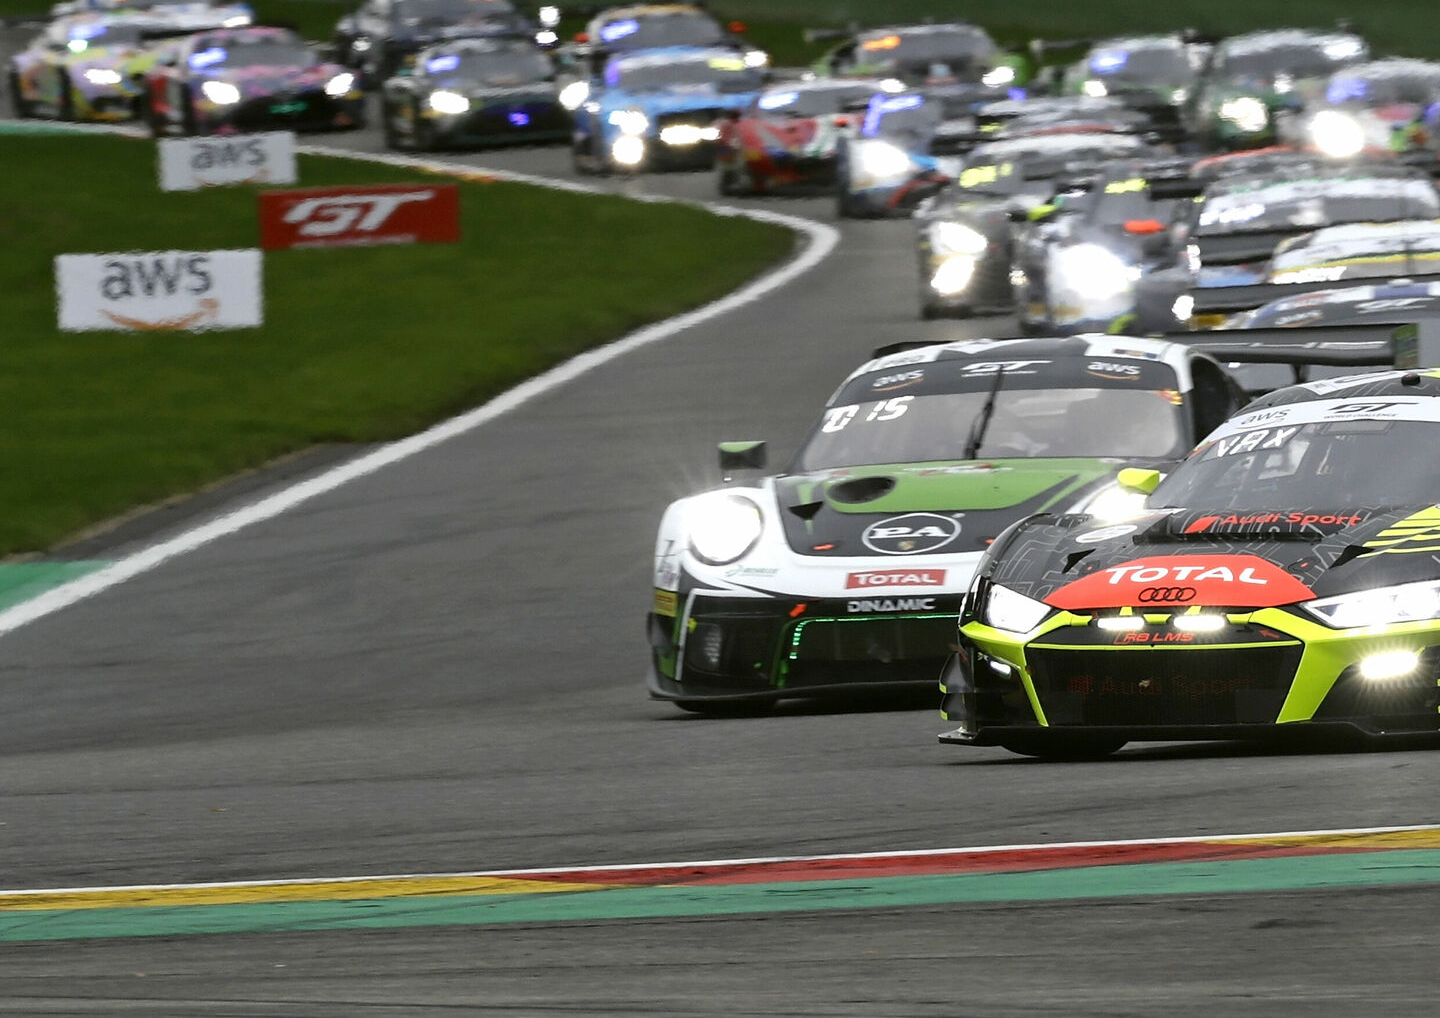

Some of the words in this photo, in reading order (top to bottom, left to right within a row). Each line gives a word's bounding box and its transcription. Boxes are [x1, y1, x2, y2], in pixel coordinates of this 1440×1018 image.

[190, 138, 268, 170] aws
[283, 190, 436, 236] GT
[102, 256, 213, 300] aws
[1088, 361, 1141, 375] aws
[873, 369, 924, 388] aws
[1328, 402, 1420, 413] GT
[1241, 408, 1292, 425] aws
[1220, 513, 1281, 526] Audi
[1286, 512, 1361, 526] Sport
[853, 573, 939, 586] TOTAL
[1105, 565, 1268, 585] TOTAL
[847, 598, 937, 613] DINAMIC
[1124, 631, 1149, 642] R8
[1152, 631, 1195, 642] LMS
